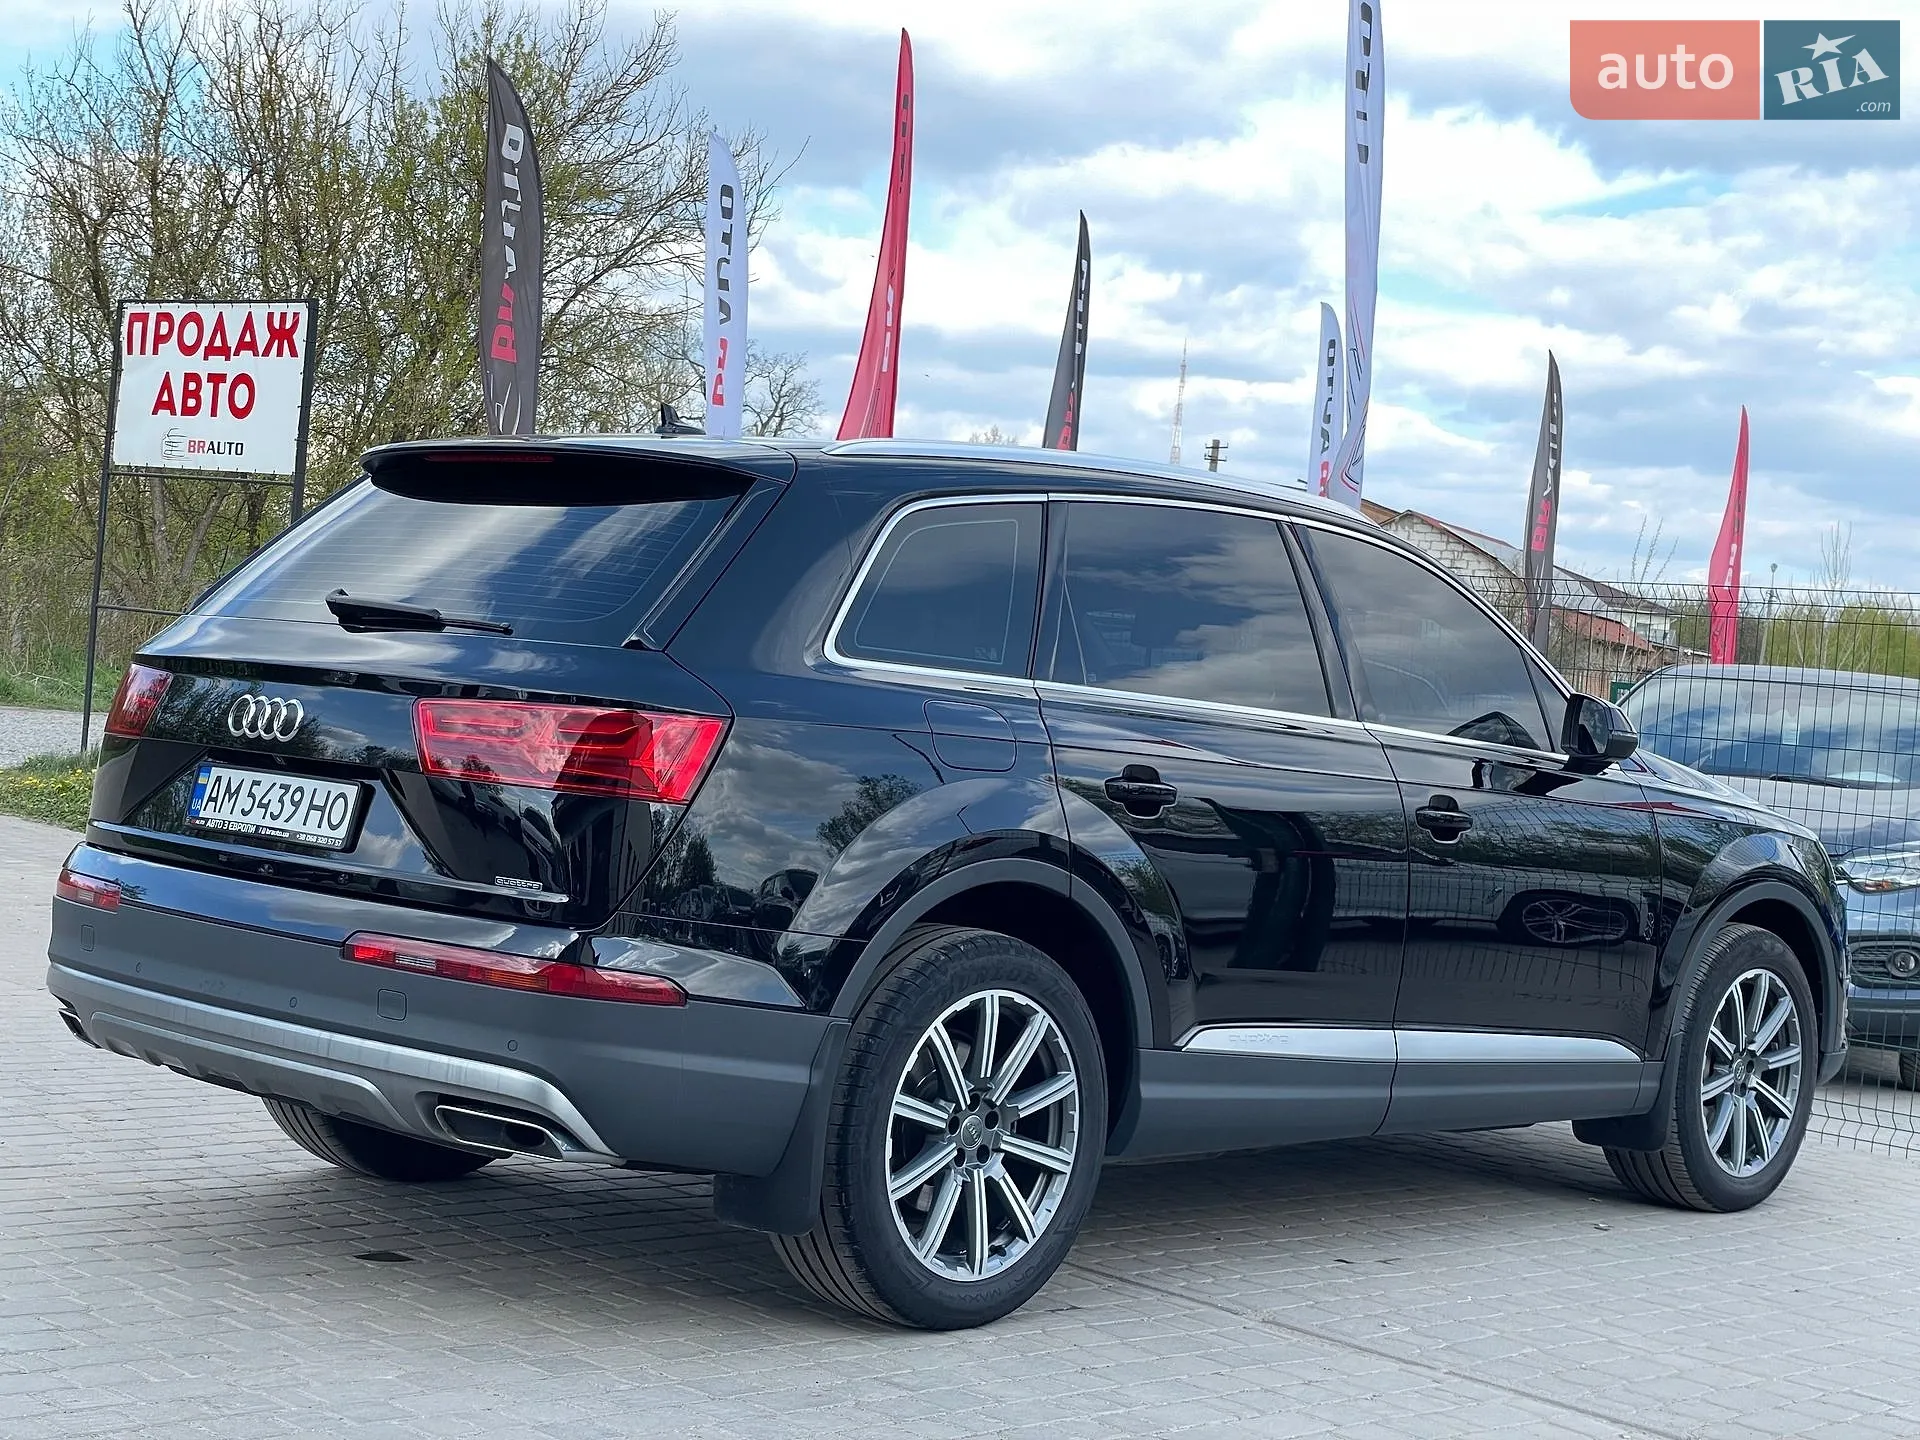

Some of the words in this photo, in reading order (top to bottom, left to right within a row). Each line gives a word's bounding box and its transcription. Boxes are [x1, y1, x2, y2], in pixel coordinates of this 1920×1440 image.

[126, 311, 300, 361] ПРОДАЖ
[151, 371, 256, 420] АВТО
[187, 439, 244, 456] BRAUTO
[191, 798, 201, 810] UA
[203, 775, 245, 815] AM
[240, 779, 305, 823] 5439
